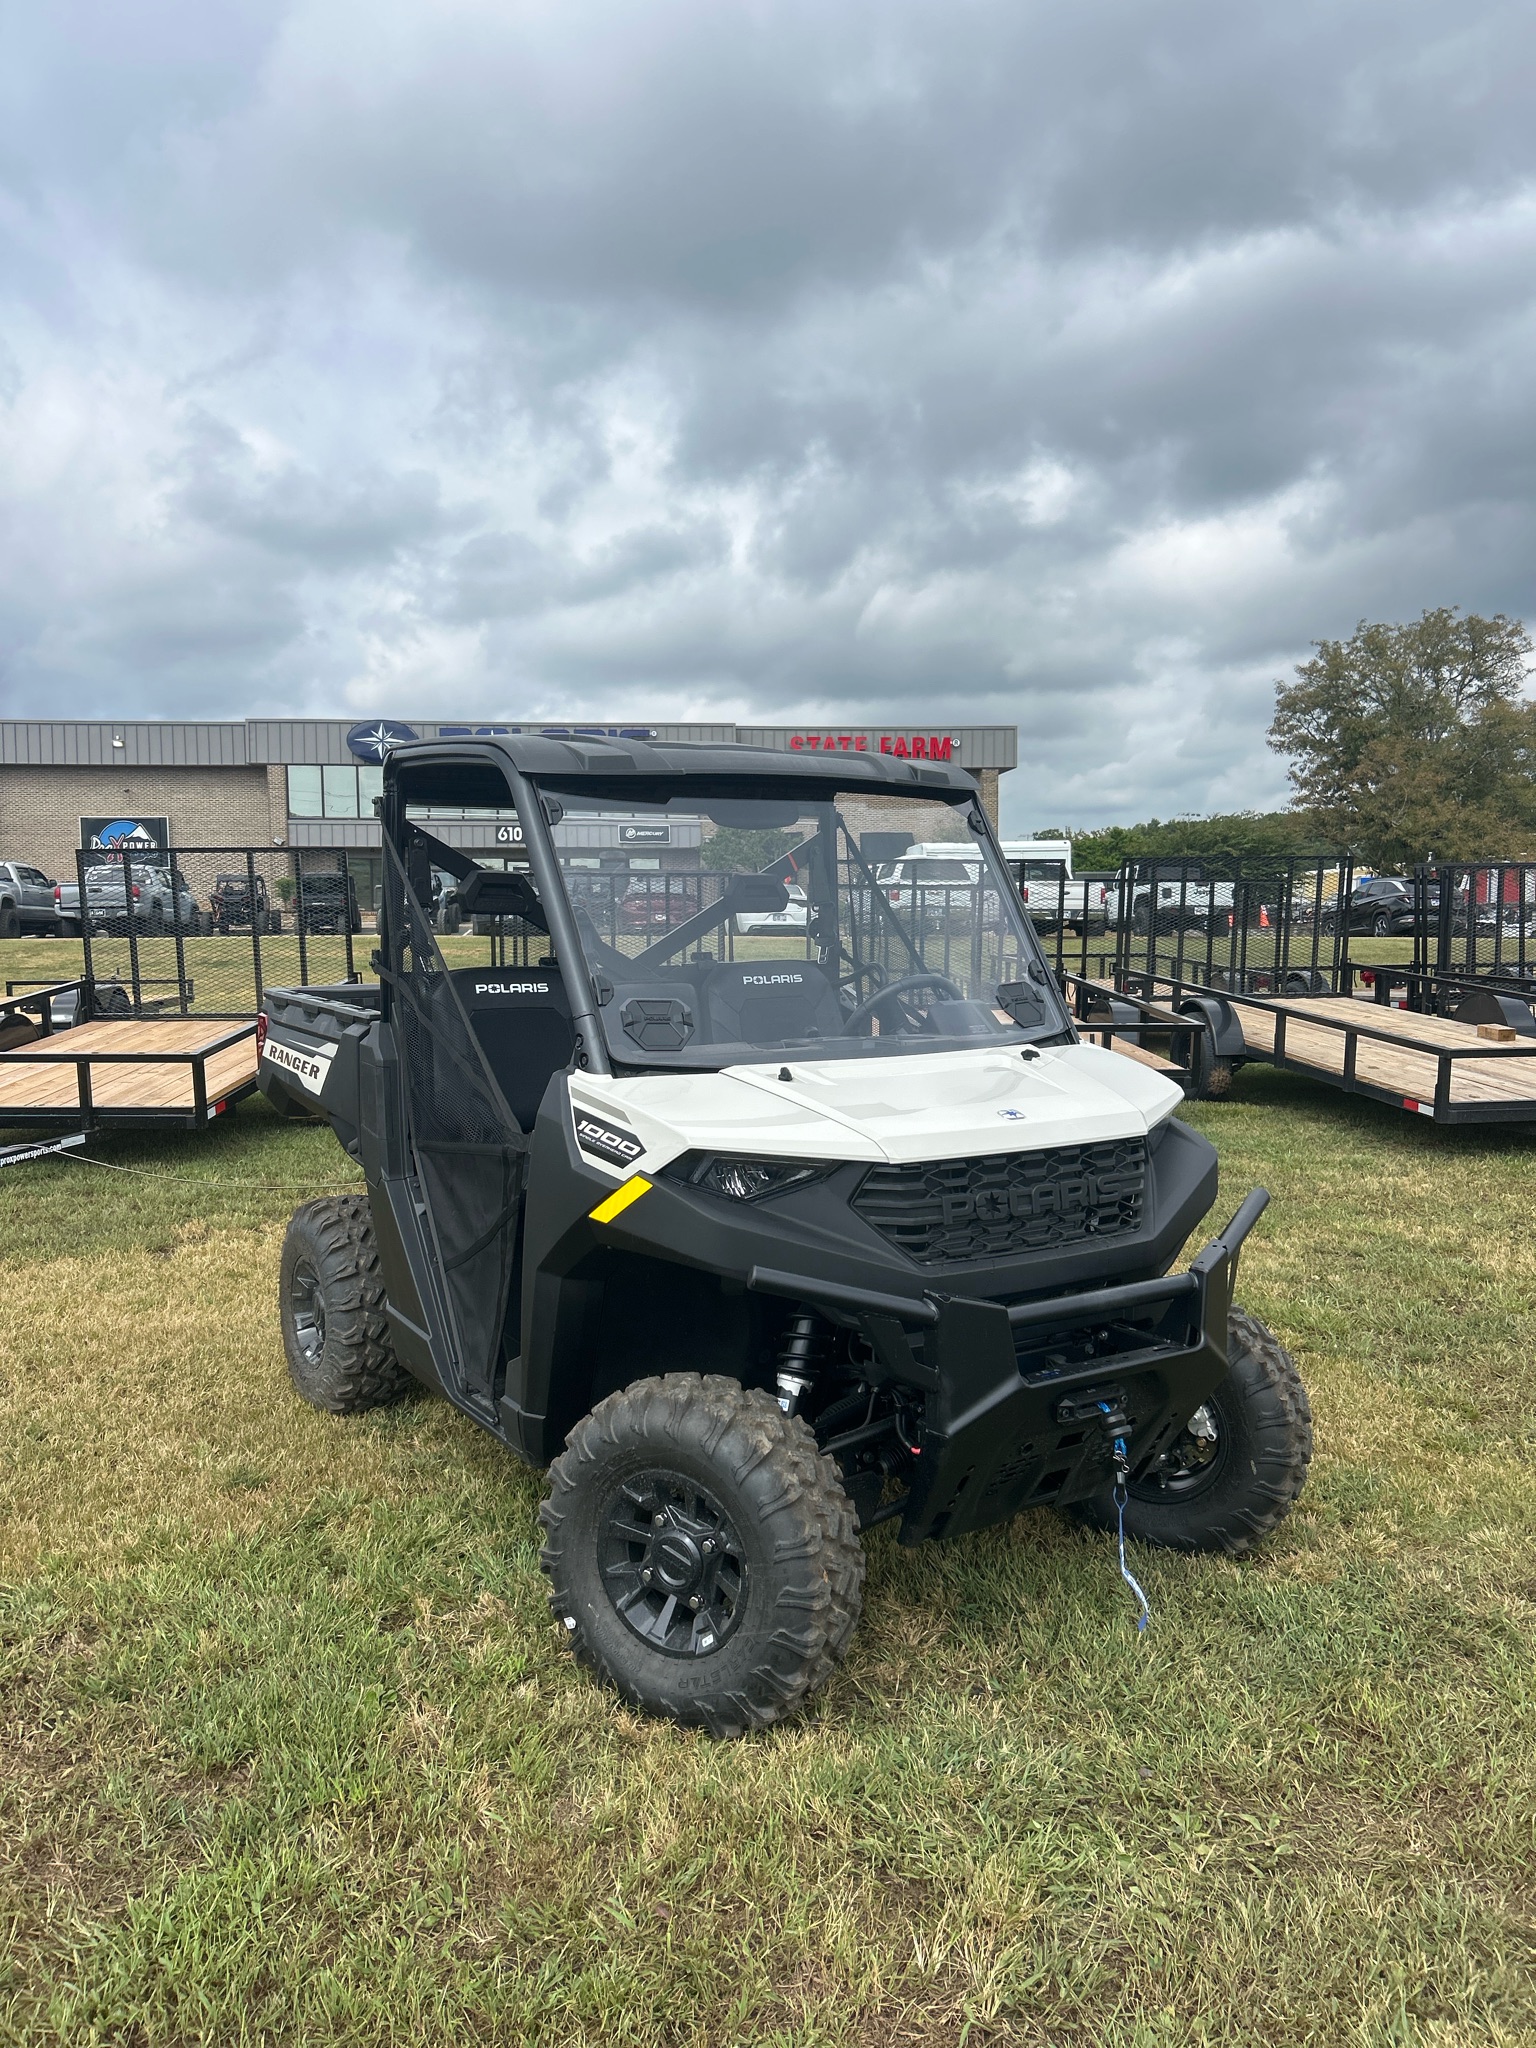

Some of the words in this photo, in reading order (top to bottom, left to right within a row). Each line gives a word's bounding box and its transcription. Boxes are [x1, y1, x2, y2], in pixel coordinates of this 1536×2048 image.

[789, 735, 868, 750] STATE
[879, 735, 952, 760] FARM
[497, 826, 523, 841] 610
[122, 841, 156, 850] POWER
[475, 982, 549, 994] POLARIS
[742, 974, 803, 985] POLARIS
[269, 1044, 320, 1080] RANGER
[577, 1120, 641, 1156] 1000
[942, 1173, 1121, 1225] POLARIS
